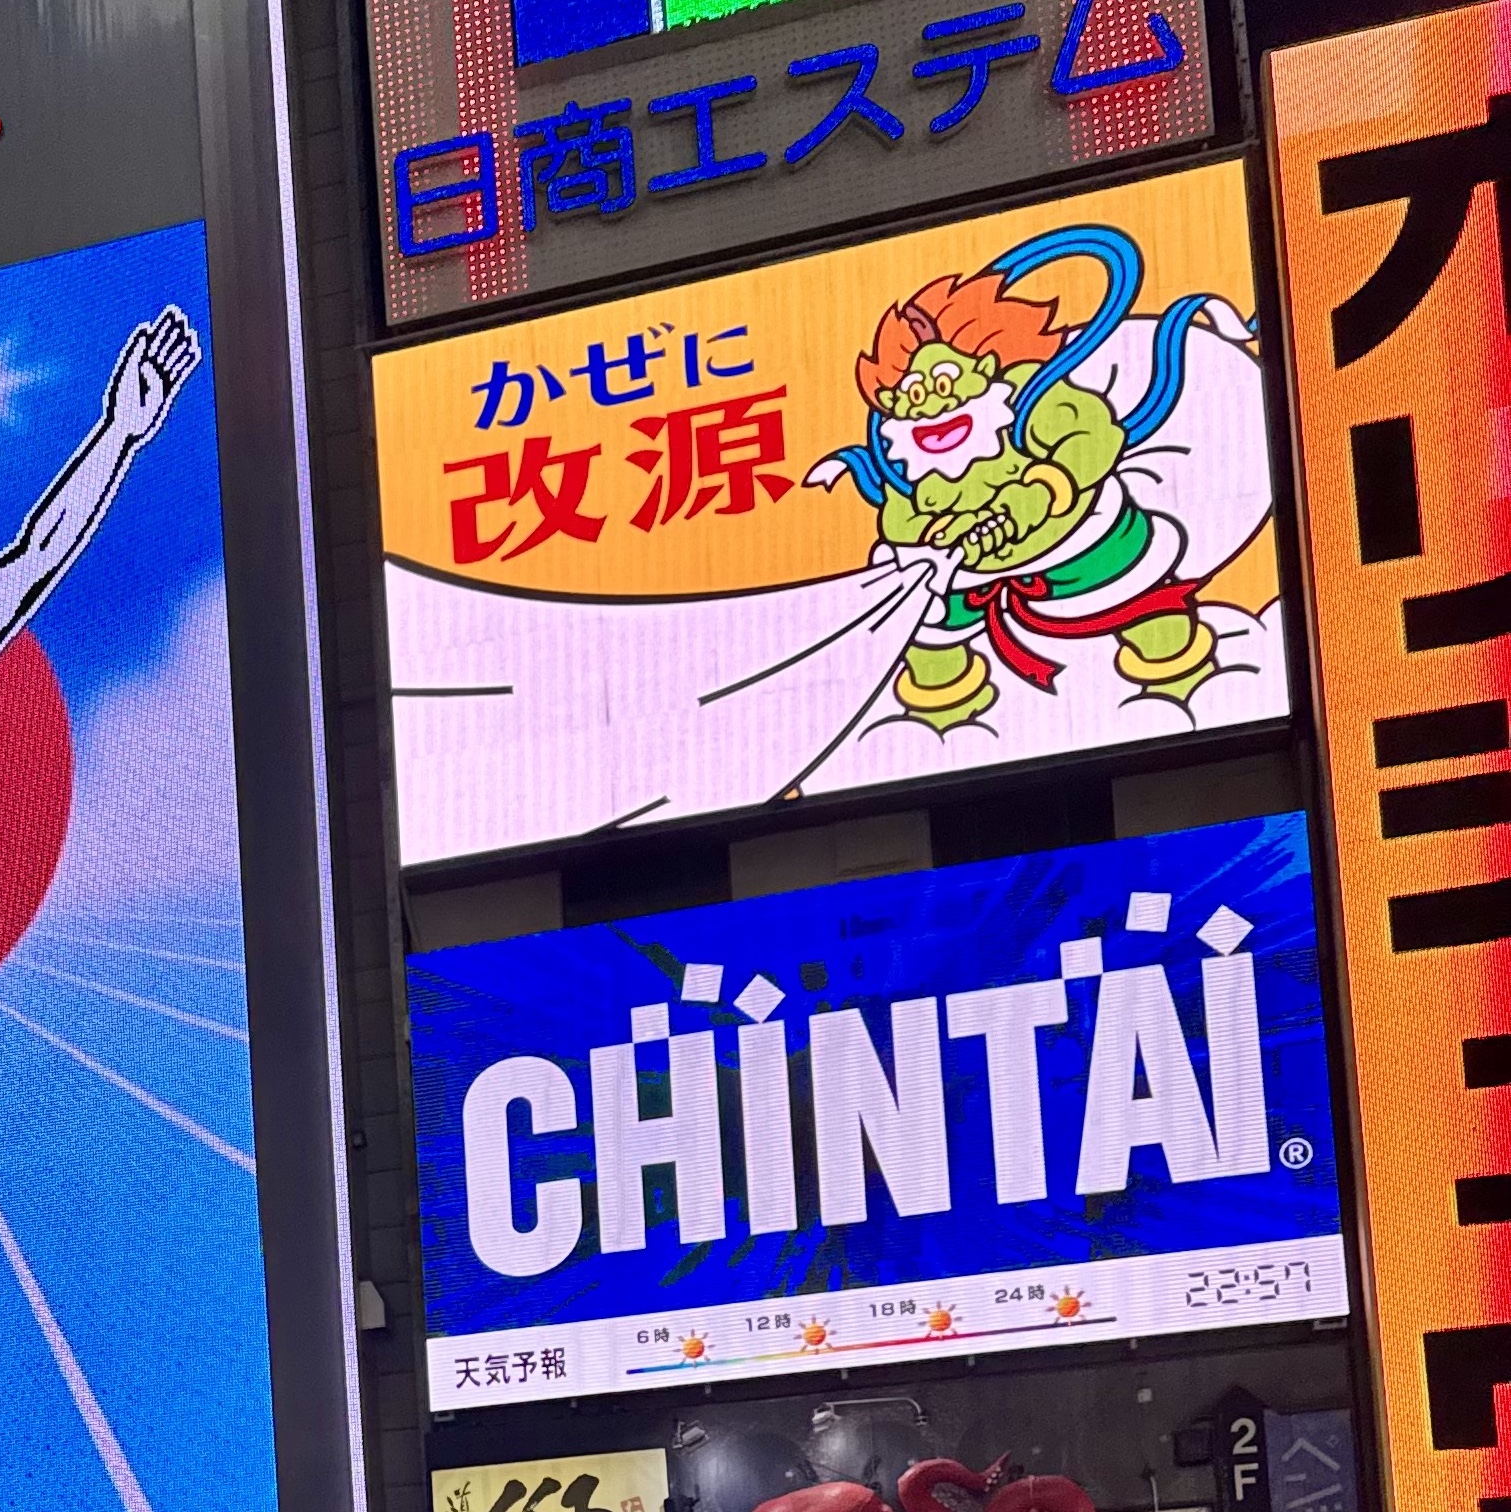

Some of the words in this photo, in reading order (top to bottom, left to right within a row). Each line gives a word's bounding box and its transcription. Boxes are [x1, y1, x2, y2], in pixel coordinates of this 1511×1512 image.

[394, 0, 1185, 257] 日商エステム
[471, 322, 755, 431] かぜに
[443, 384, 795, 565] 改源
[462, 891, 1271, 1277] CHINTAI
[636, 1327, 670, 1345] 6時
[745, 1314, 792, 1333] 12時
[868, 1299, 917, 1318] 18時
[994, 1285, 1046, 1303] 24時
[1185, 1261, 1310, 1308] 22:57
[454, 1347, 567, 1389] 天気予報
[1230, 1417, 1259, 1500] 2F
